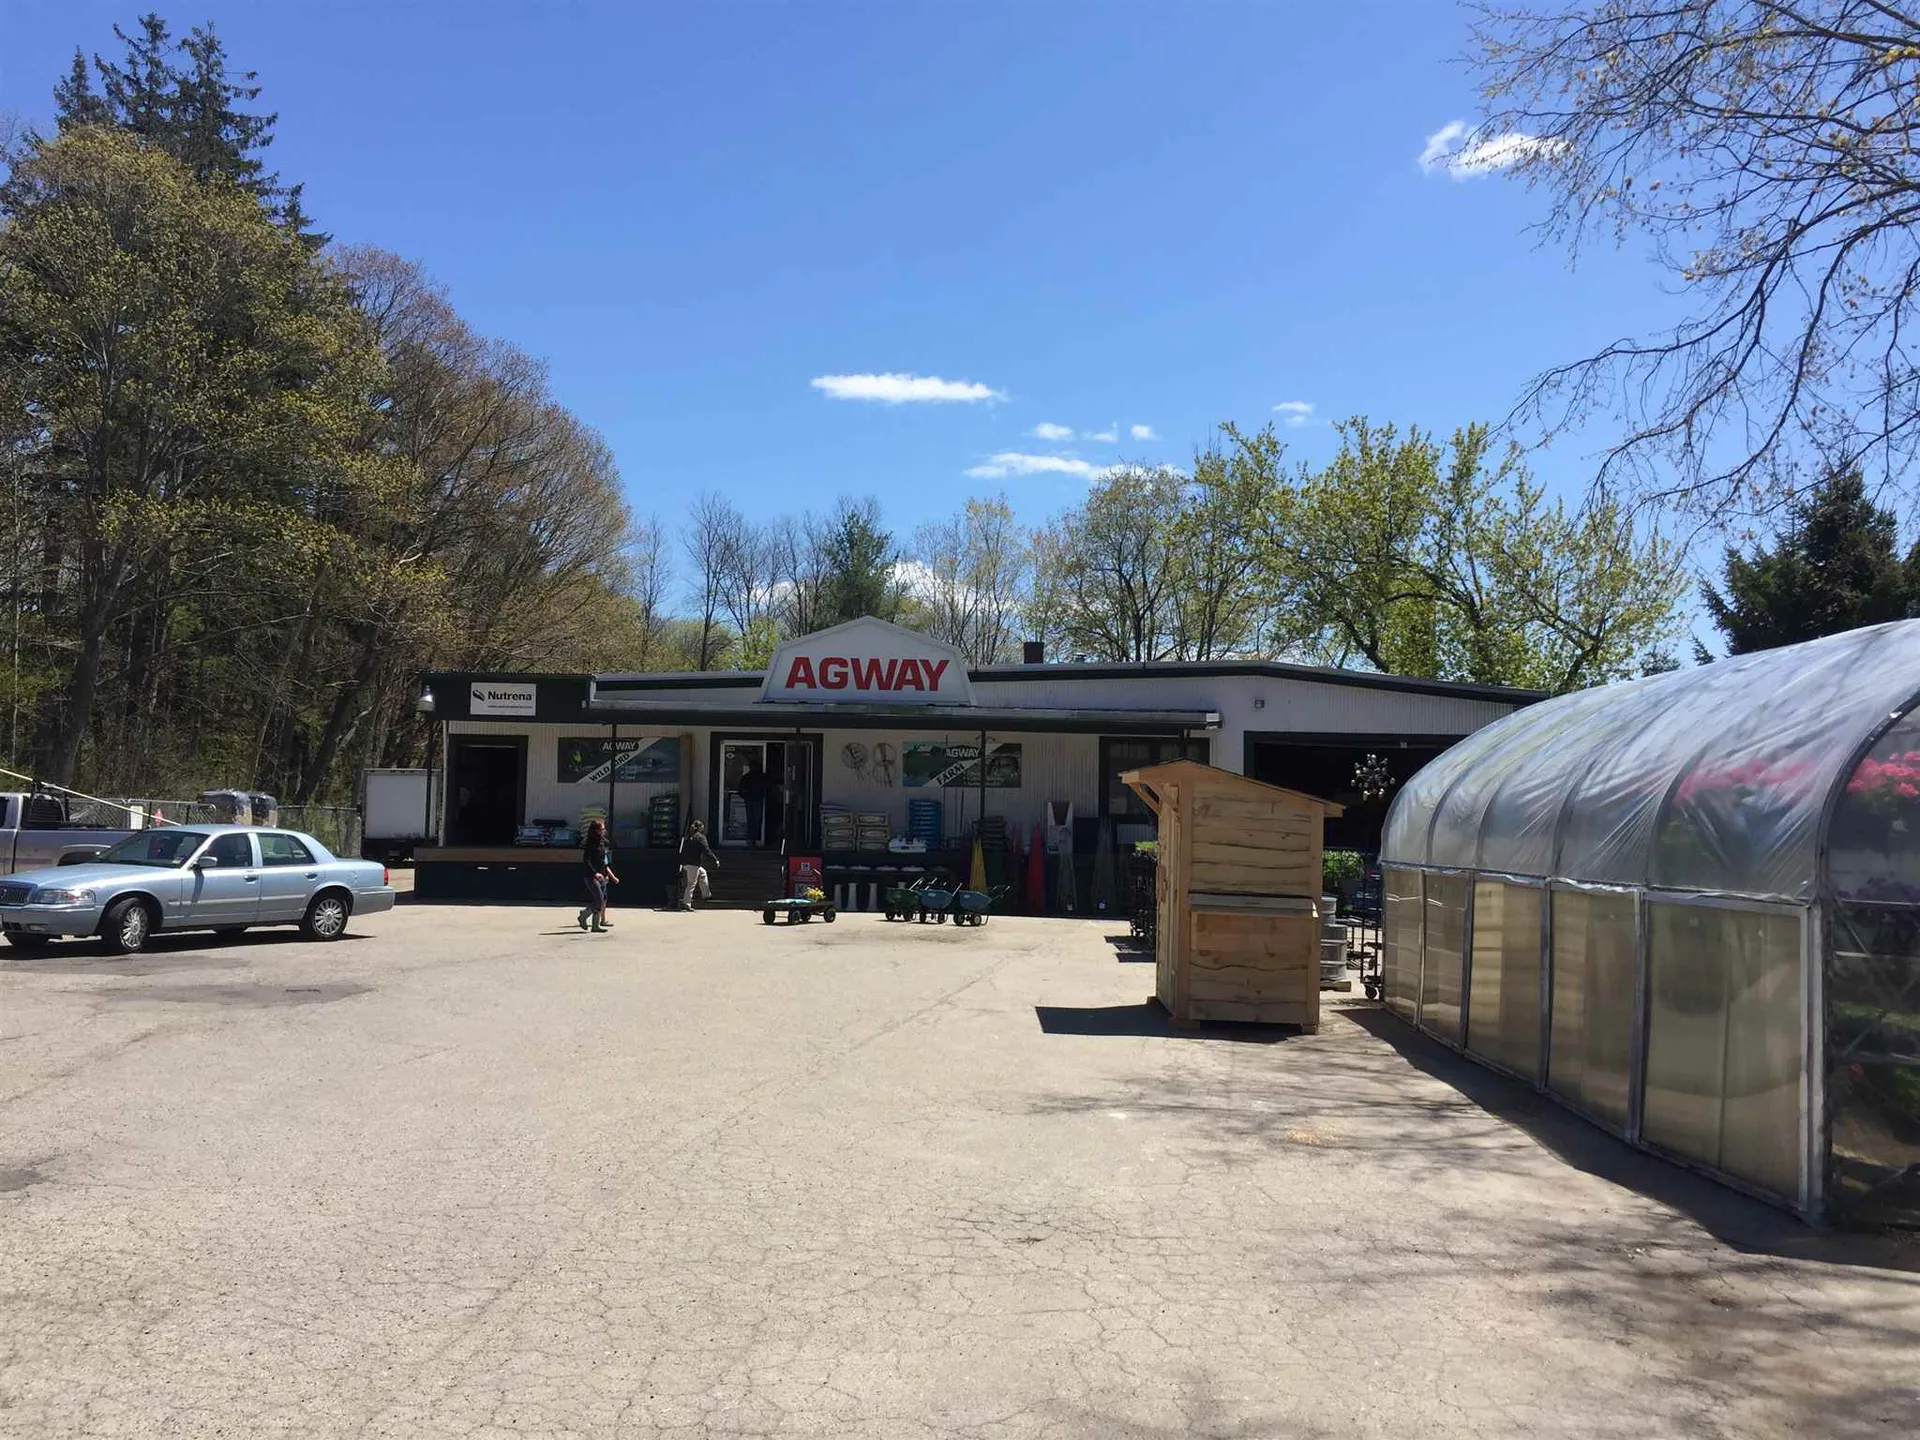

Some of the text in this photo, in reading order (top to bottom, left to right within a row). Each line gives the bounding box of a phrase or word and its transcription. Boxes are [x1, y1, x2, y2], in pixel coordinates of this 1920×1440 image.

[785, 656, 951, 691] AGWAY
[487, 691, 532, 701] Nutrena
[945, 748, 980, 758] AGWAY
[589, 765, 610, 782] WILD
[612, 752, 630, 768] IRD
[936, 762, 966, 786] FARM
